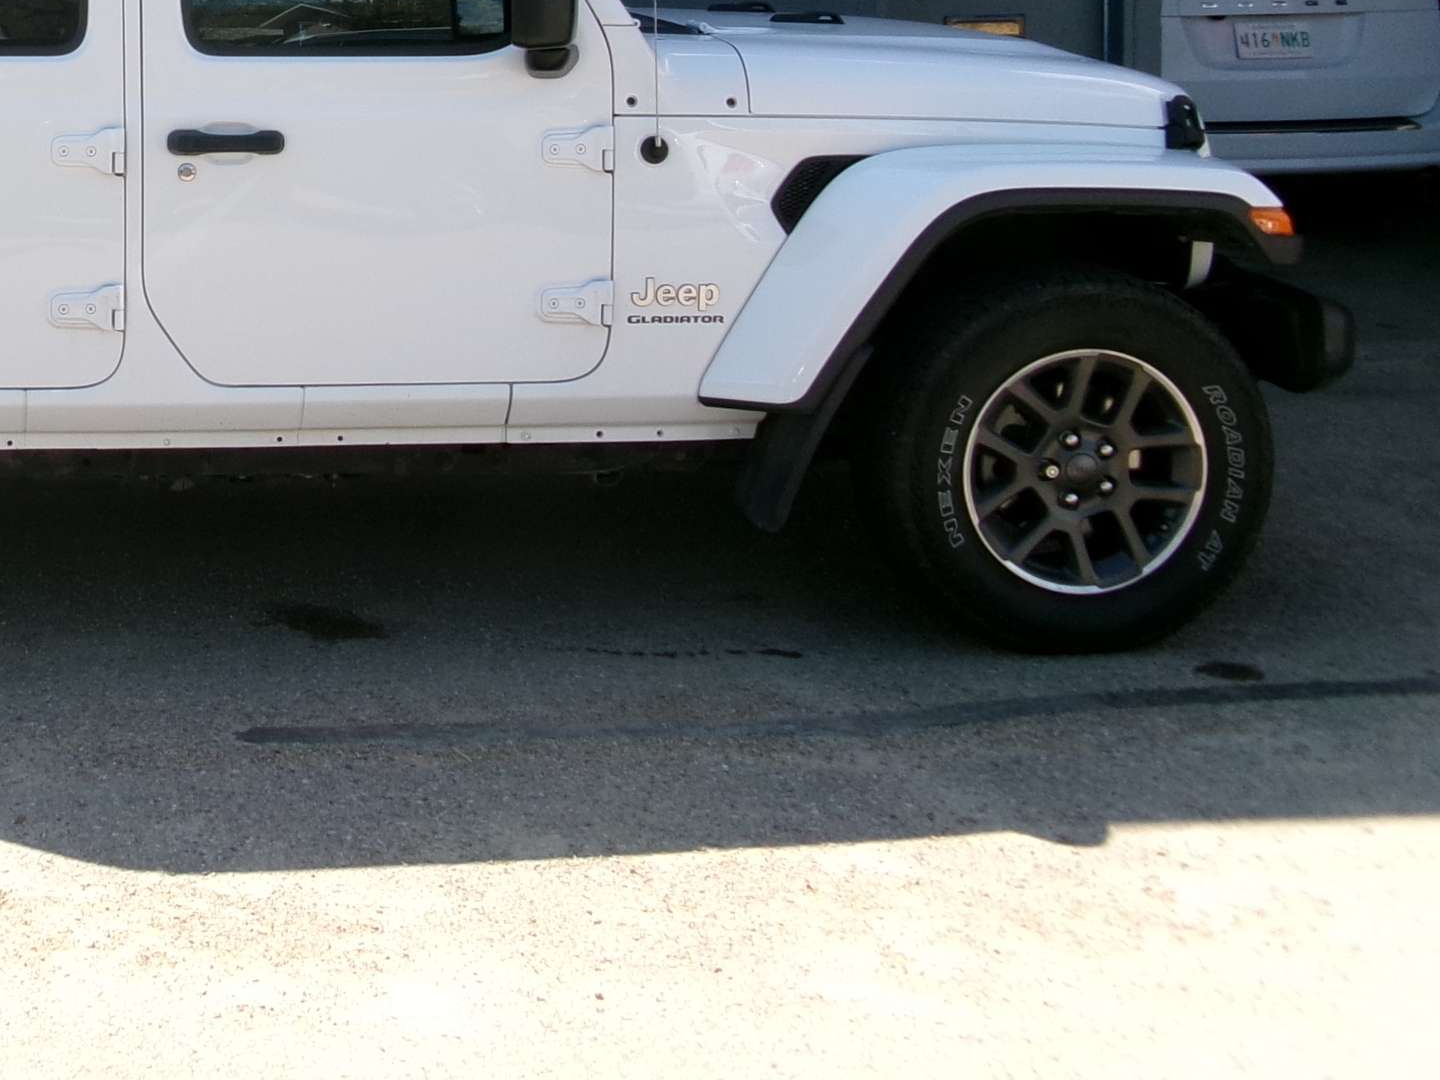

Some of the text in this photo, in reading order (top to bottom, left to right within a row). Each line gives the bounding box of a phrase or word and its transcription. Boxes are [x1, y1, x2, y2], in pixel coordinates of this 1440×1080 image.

[1239, 31, 1311, 49] 416 NKB
[629, 276, 721, 312] Jeep
[627, 315, 724, 324] GLADIATOR
[936, 394, 973, 548] NEXEN
[1196, 384, 1246, 571] ROADIAN AT
